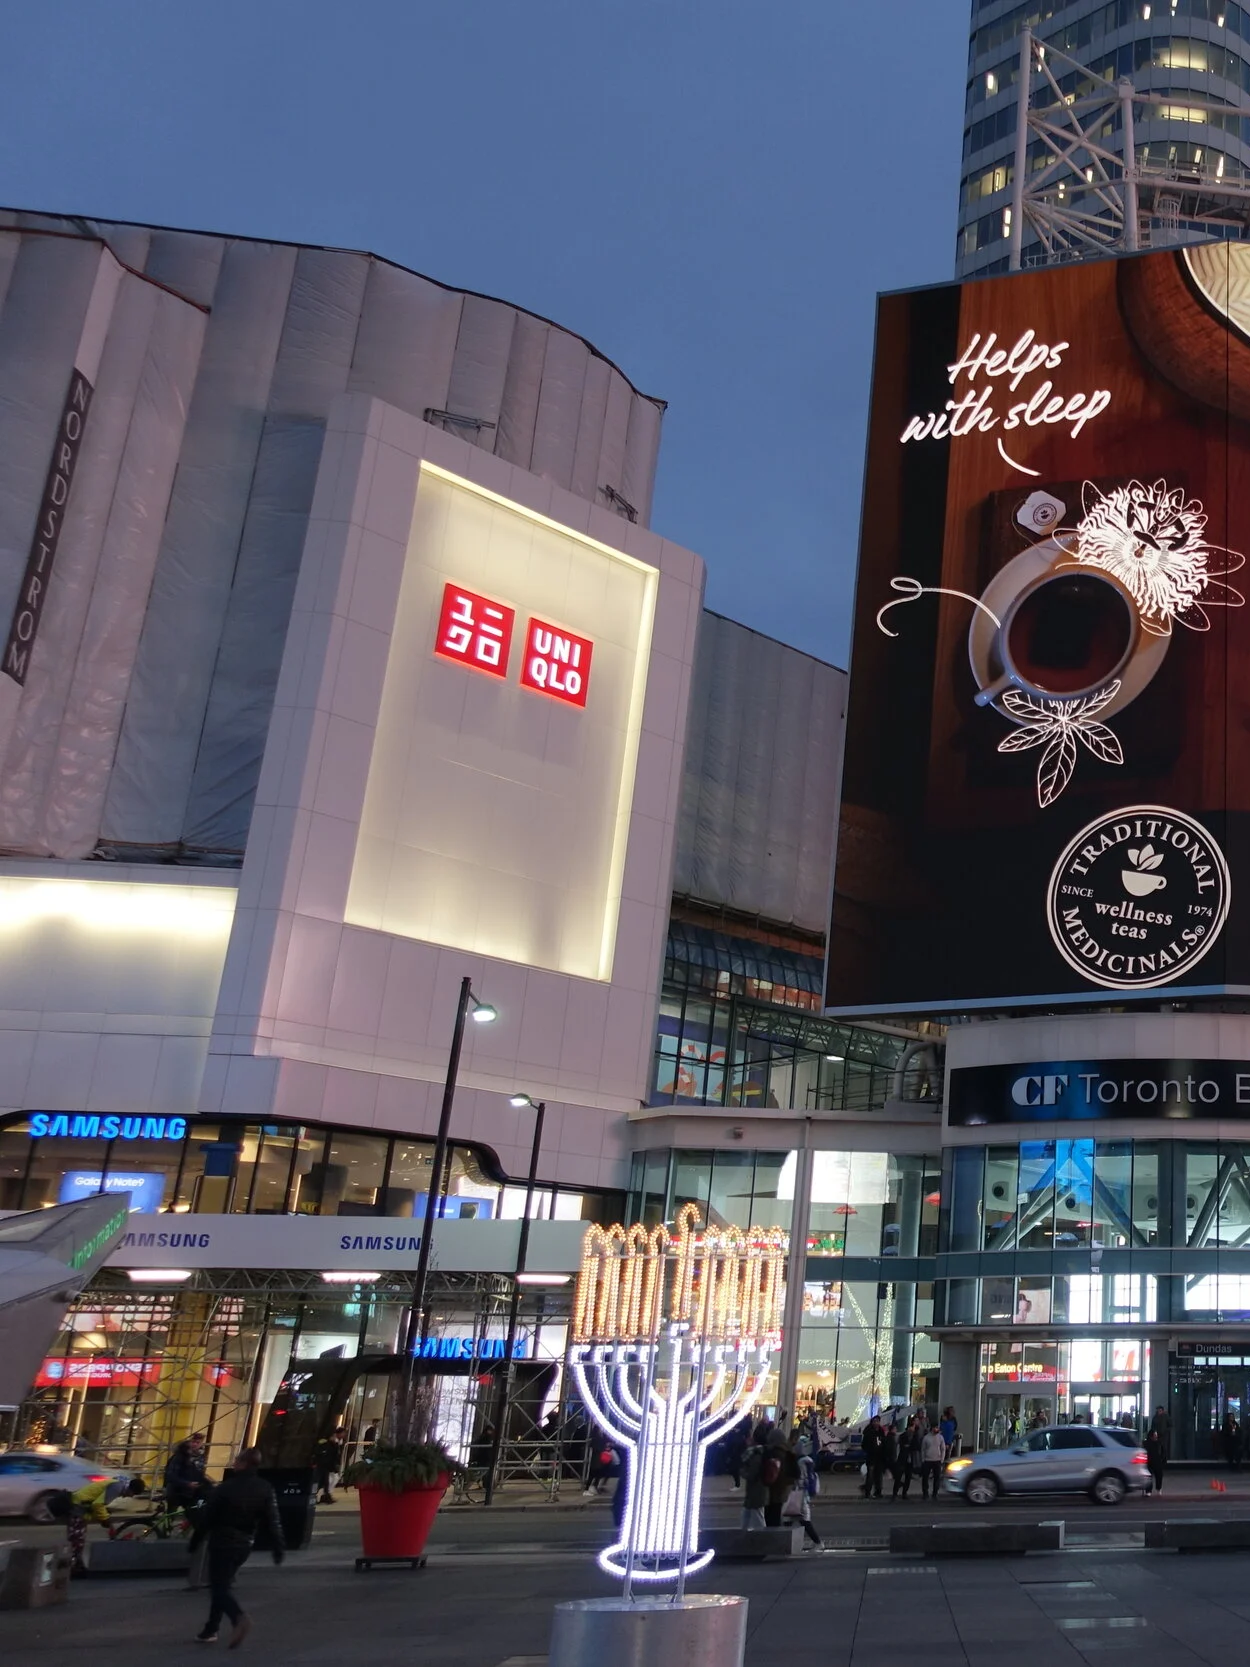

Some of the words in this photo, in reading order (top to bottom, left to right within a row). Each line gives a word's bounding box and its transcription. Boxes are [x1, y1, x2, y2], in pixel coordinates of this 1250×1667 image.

[947, 330, 1069, 391] Helps
[901, 386, 999, 443] with
[1004, 381, 1112, 438] sleep
[8, 379, 88, 677] NORDSTROM
[535, 628, 581, 667] UNI
[531, 657, 581, 695] QLO
[1070, 820, 1214, 894] TRADITIONAL
[1061, 885, 1094, 898] SINCE
[1095, 901, 1173, 926] wellness
[1187, 905, 1213, 917] 1974
[1111, 922, 1148, 939] teas
[1012, 1075, 1068, 1106] CF
[1078, 1073, 1220, 1104] Toronto
[30, 1114, 186, 1140] SAMSUNG
[75, 1177, 112, 1188] Galay
[122, 1233, 210, 1248] AMSUNG
[1196, 1344, 1232, 1353] Dundas
[994, 1362, 1016, 1373] Eaton
